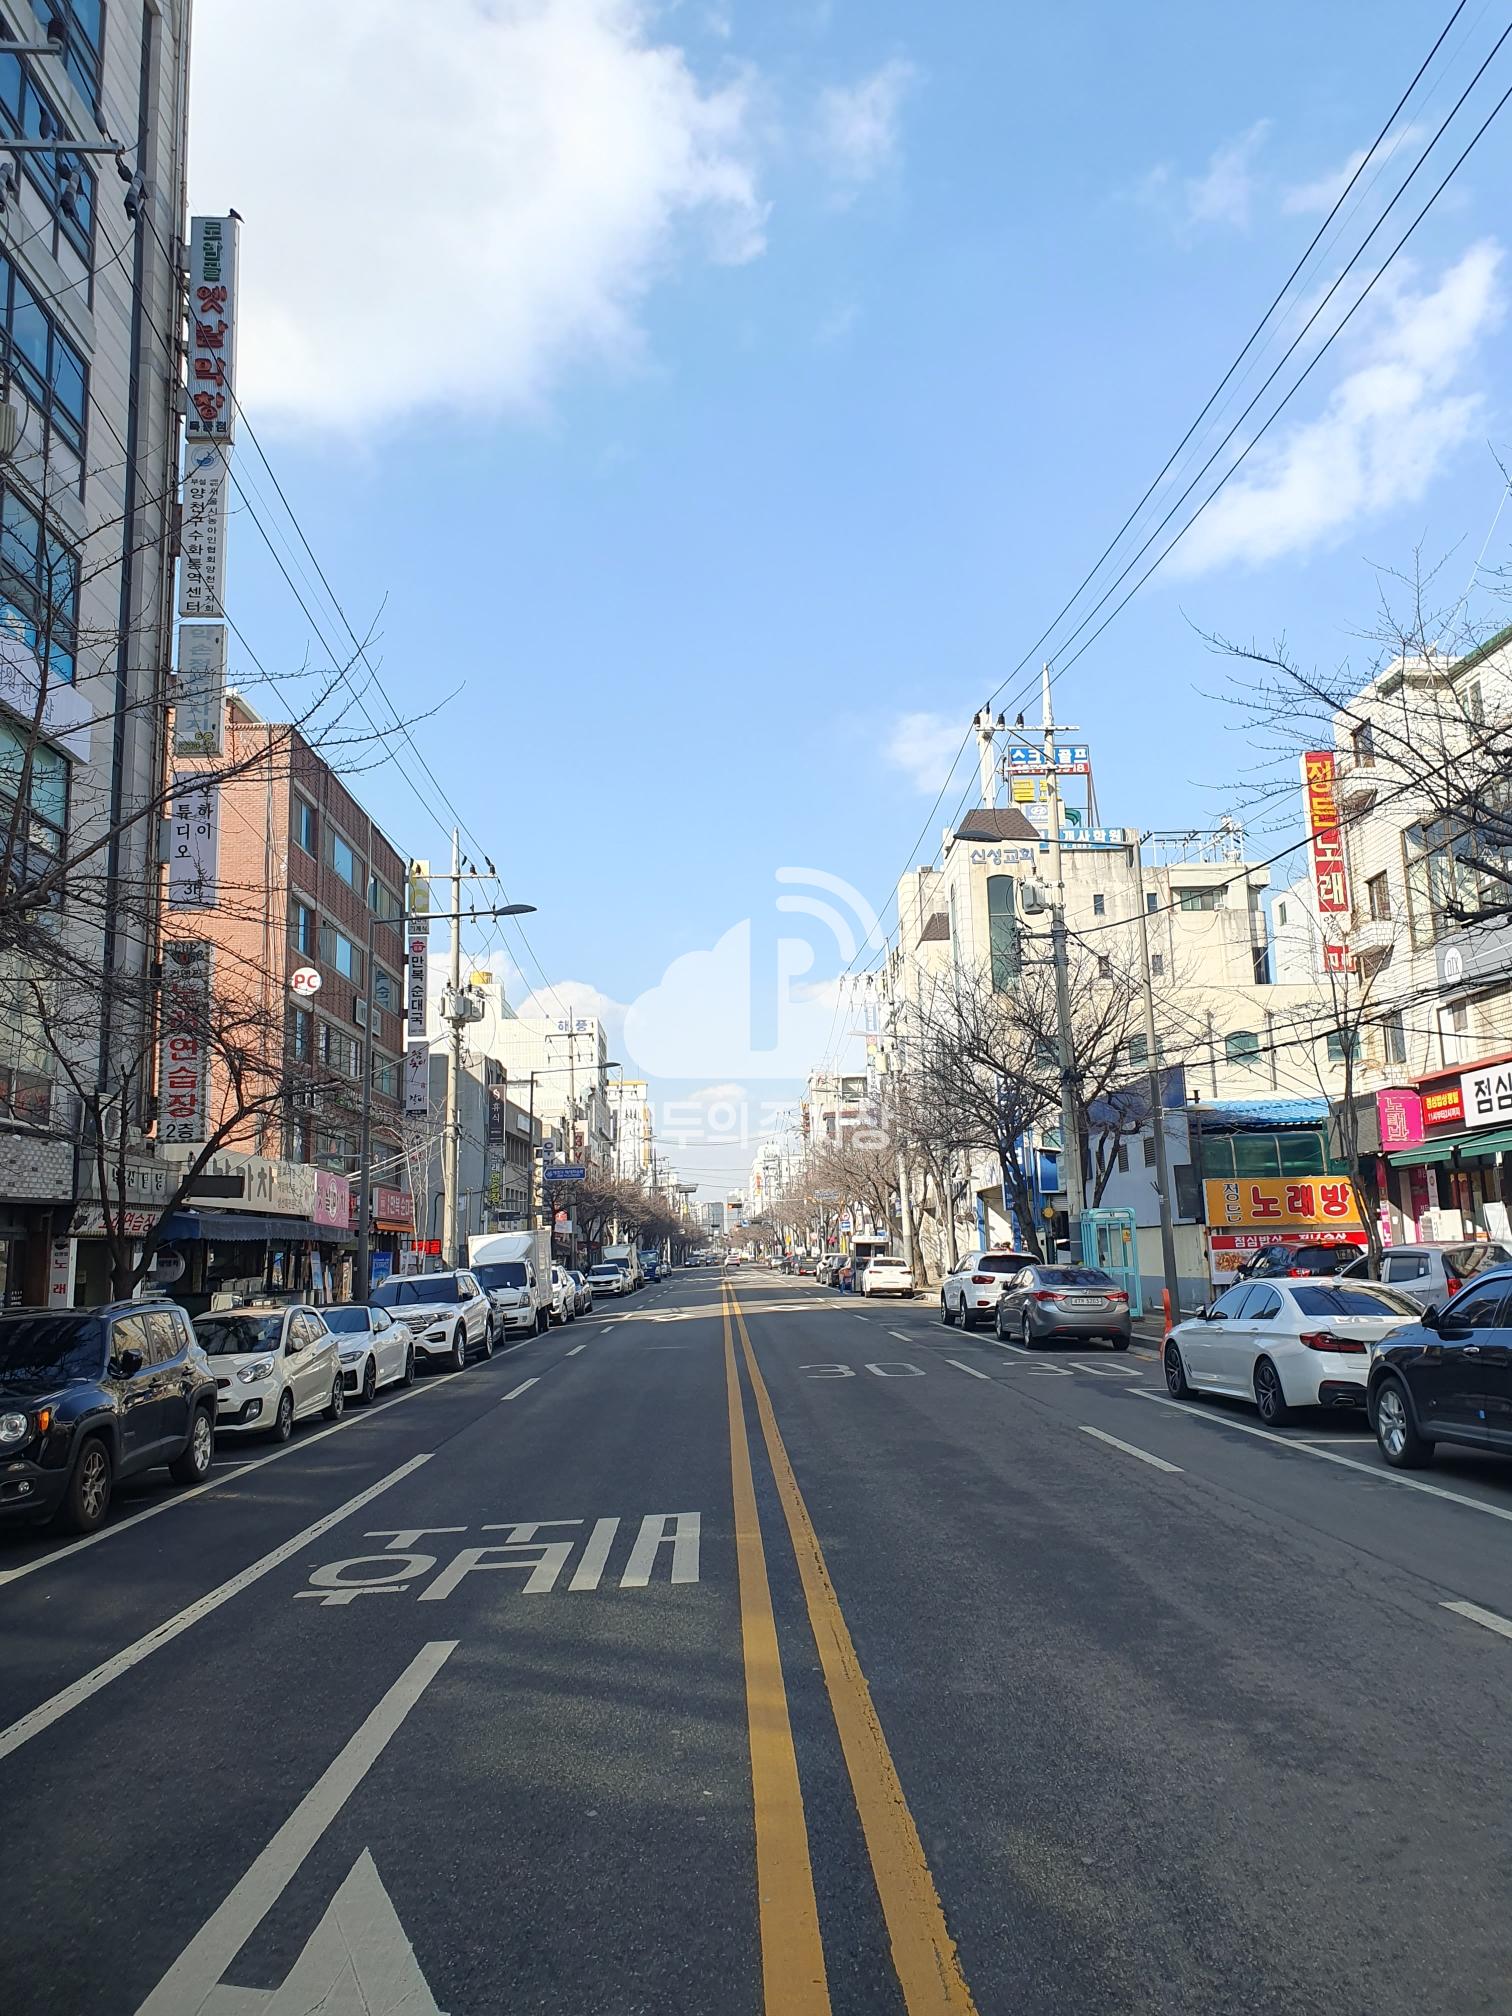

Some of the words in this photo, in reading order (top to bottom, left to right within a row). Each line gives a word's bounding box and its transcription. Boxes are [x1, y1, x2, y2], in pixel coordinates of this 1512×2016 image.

[194, 285, 229, 421] 옛날막창
[185, 487, 206, 613] 양천구수화통역센터
[1013, 748, 1088, 764] 스크골프
[970, 847, 1034, 866] 신성교회
[411, 956, 425, 982] 만복
[294, 974, 318, 989] PC
[410, 985, 424, 1025] 순대국
[165, 1123, 194, 1139] 2층
[1223, 1183, 1242, 1223] 정든
[1250, 1183, 1350, 1219] 노래방
[799, 1362, 926, 1379] 30
[1002, 1361, 1143, 1377] 30
